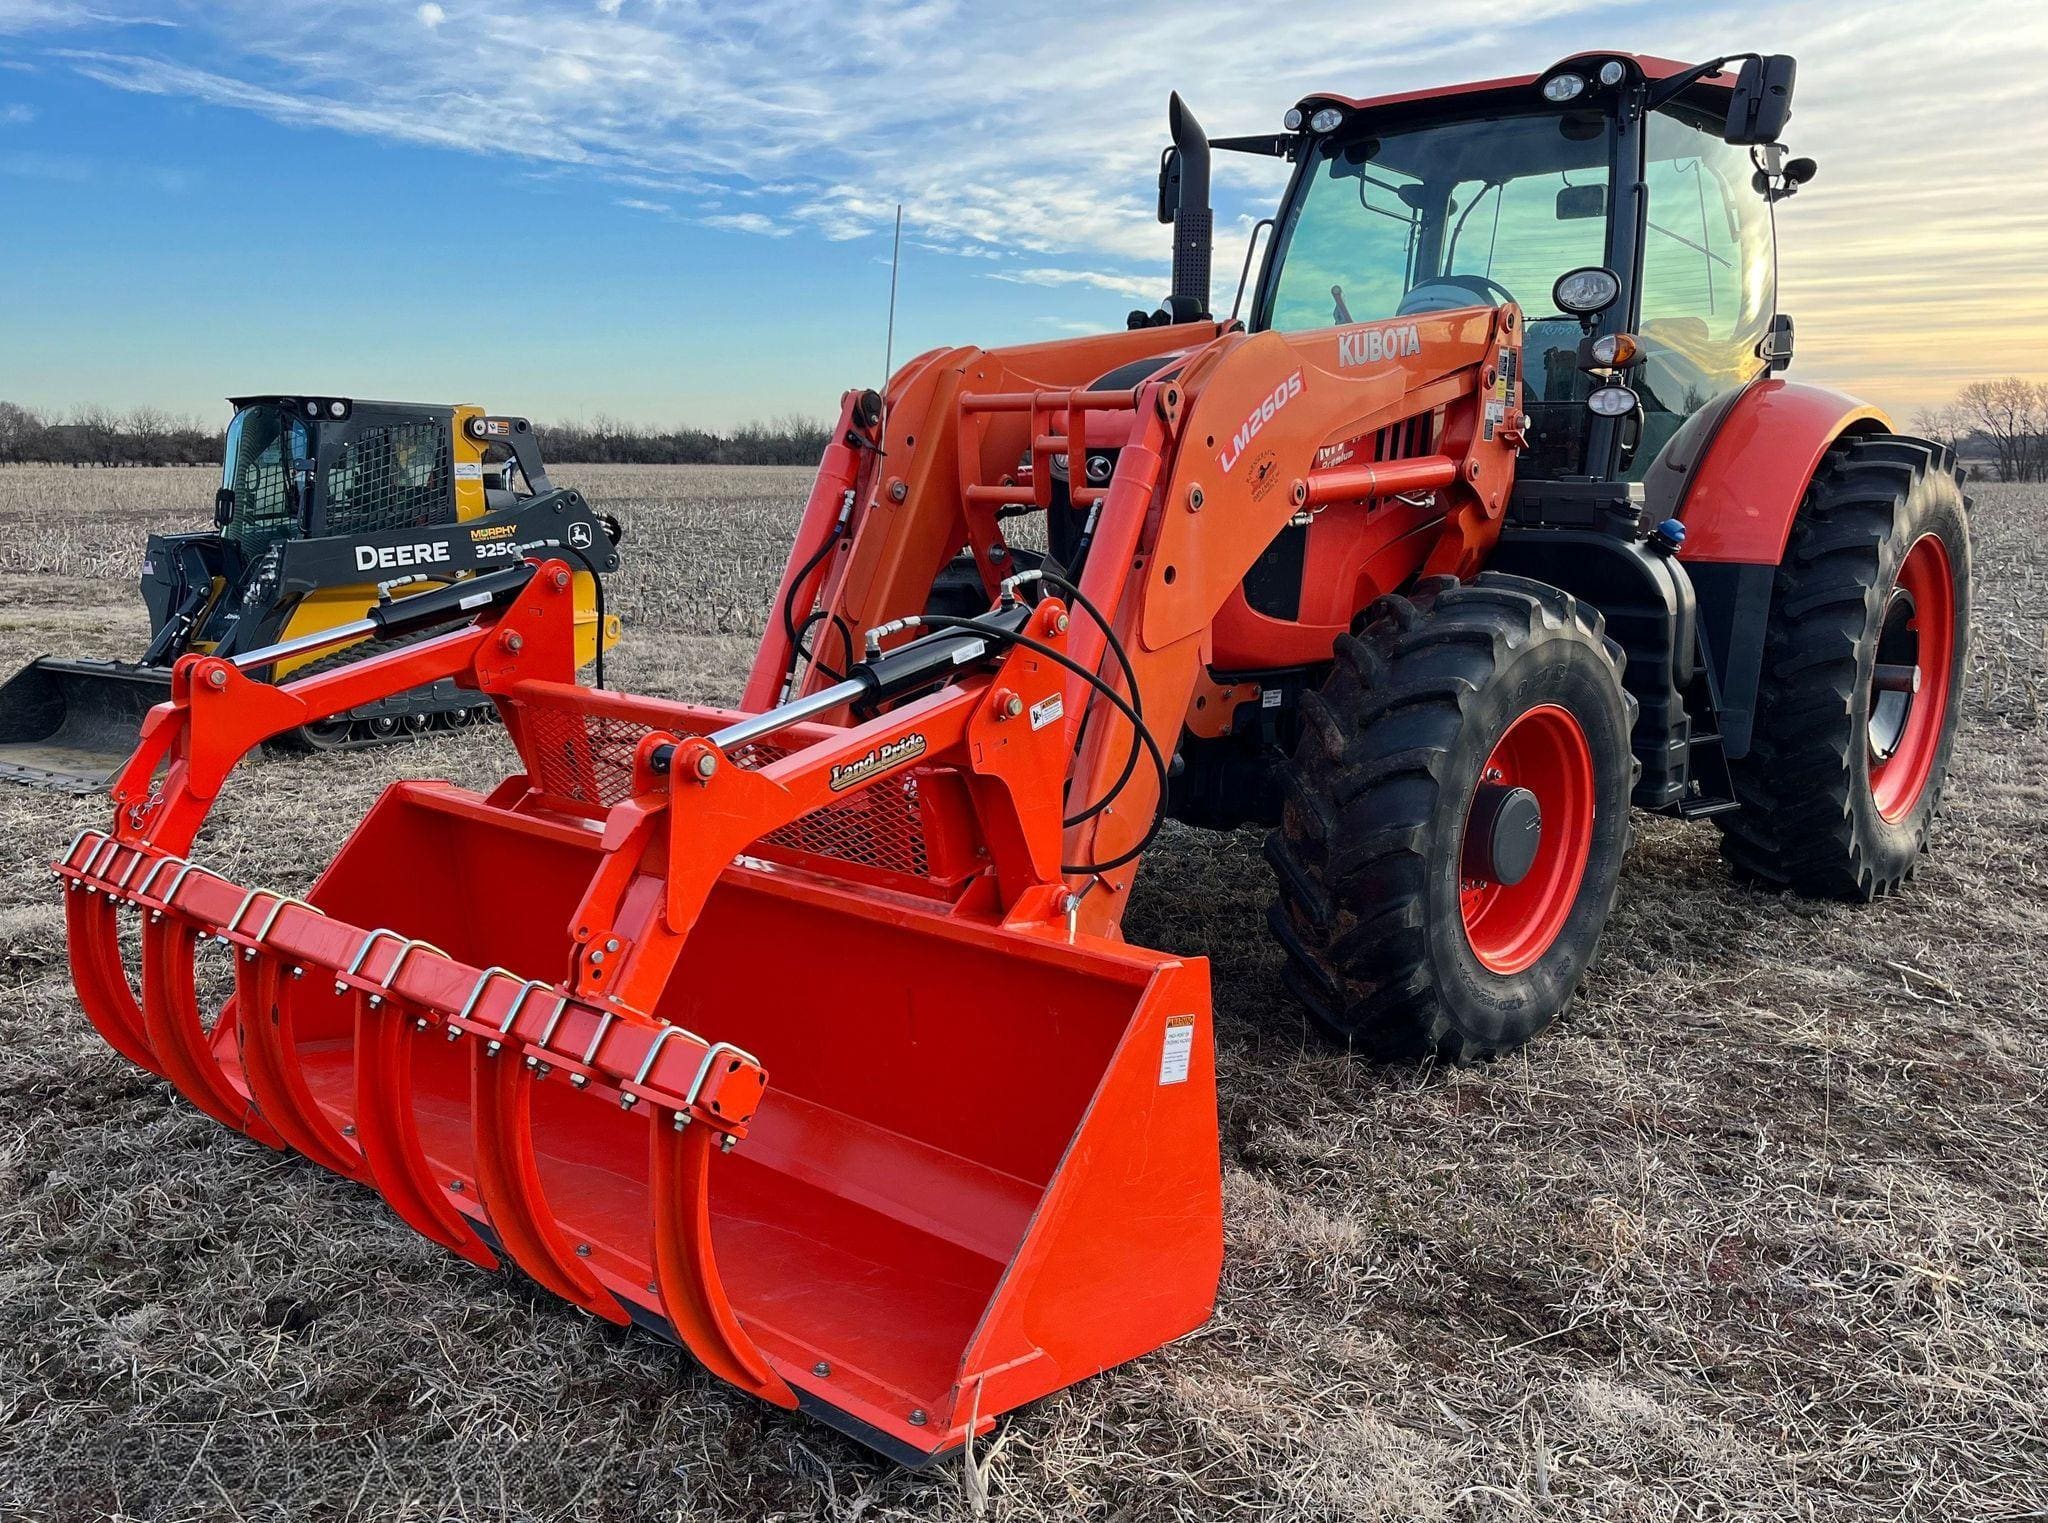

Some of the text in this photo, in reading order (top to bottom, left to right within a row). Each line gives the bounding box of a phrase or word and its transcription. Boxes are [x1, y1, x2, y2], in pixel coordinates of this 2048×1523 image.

[1339, 325, 1421, 368] KUBOTA
[1220, 371, 1301, 473] LM2605
[1321, 449, 1354, 469] Premium
[470, 524, 517, 539] MURPHY
[355, 541, 450, 571] DEERE
[831, 733, 926, 785] Land Pride
